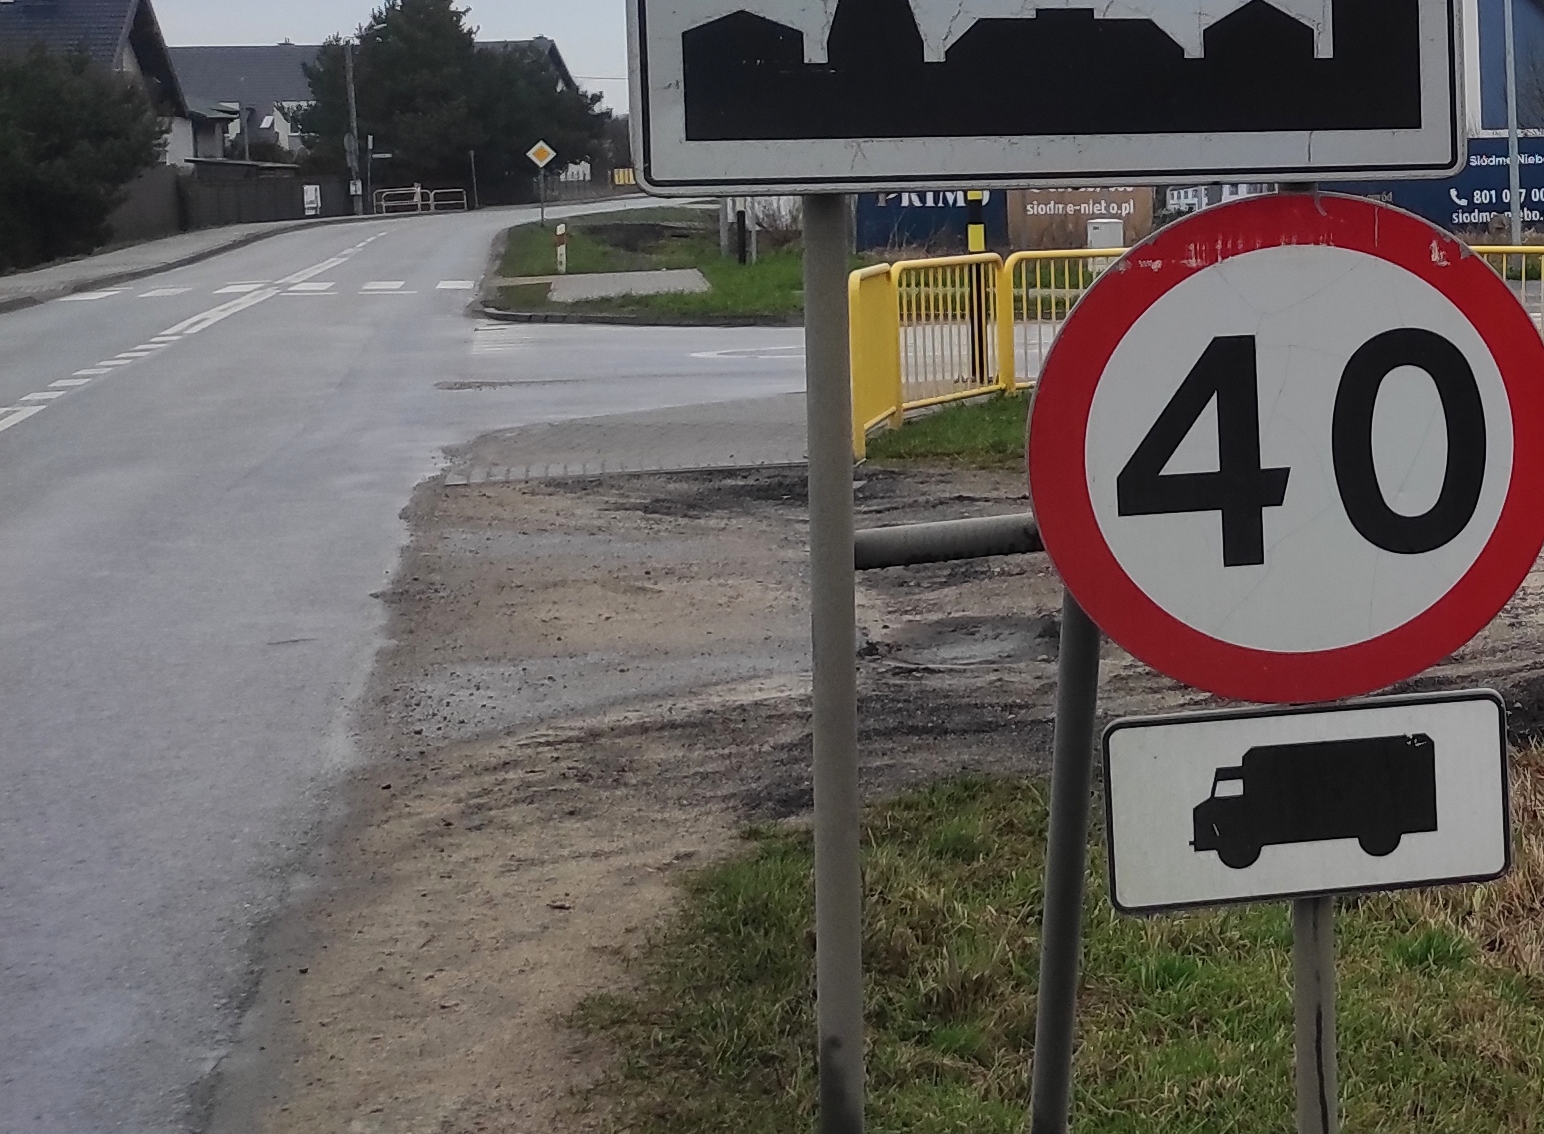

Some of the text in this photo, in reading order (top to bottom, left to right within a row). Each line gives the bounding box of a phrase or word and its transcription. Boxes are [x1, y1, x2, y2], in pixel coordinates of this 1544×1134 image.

[877, 190, 990, 207] PRIM
[1473, 189, 1497, 204] 801
[1502, 188, 1527, 203] 07
[1116, 326, 1487, 568] 40
